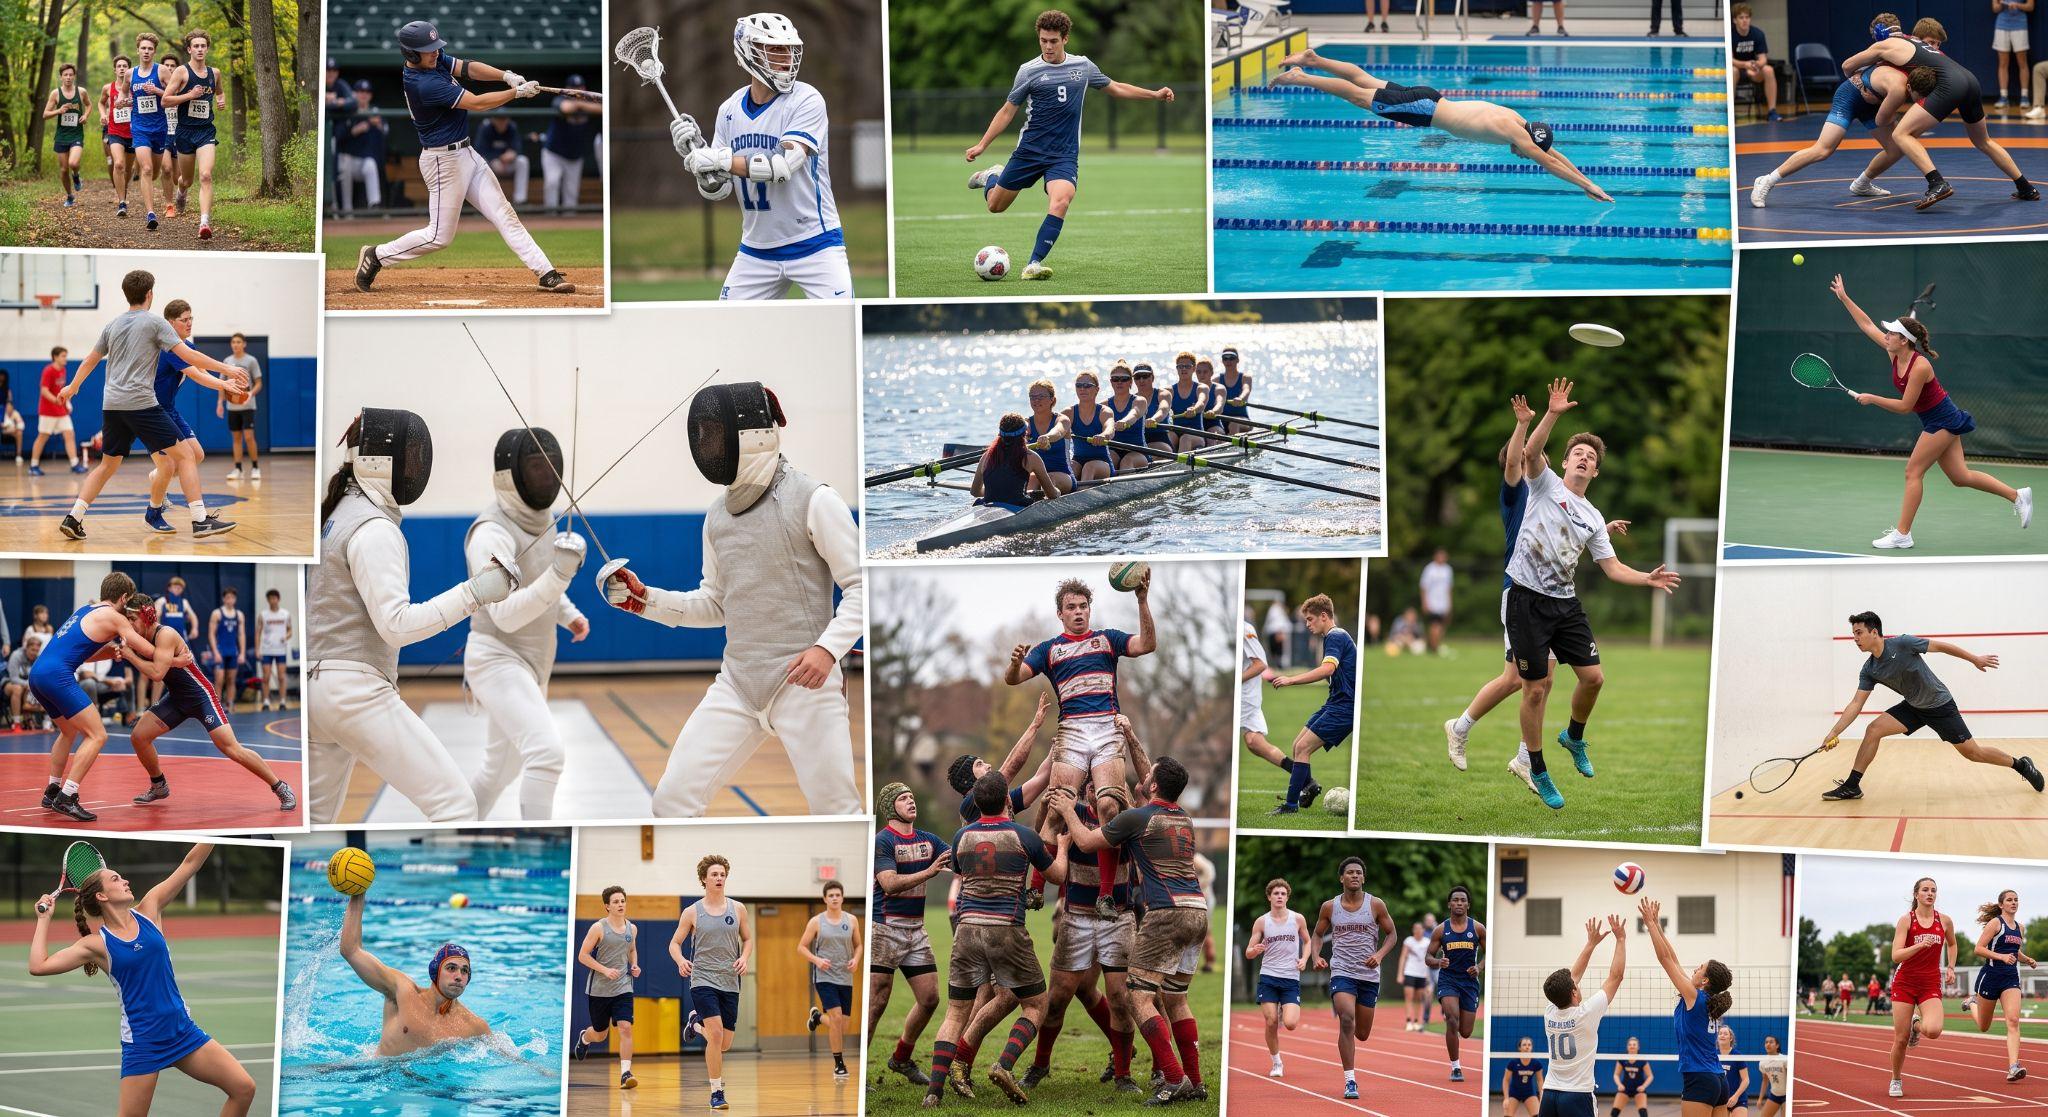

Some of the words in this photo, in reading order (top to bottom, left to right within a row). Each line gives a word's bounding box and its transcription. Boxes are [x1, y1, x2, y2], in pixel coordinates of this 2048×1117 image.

[1057, 85, 1067, 103] 9
[740, 176, 771, 210] 11
[975, 841, 996, 878] 3
[1550, 1033, 1577, 1060] 10
